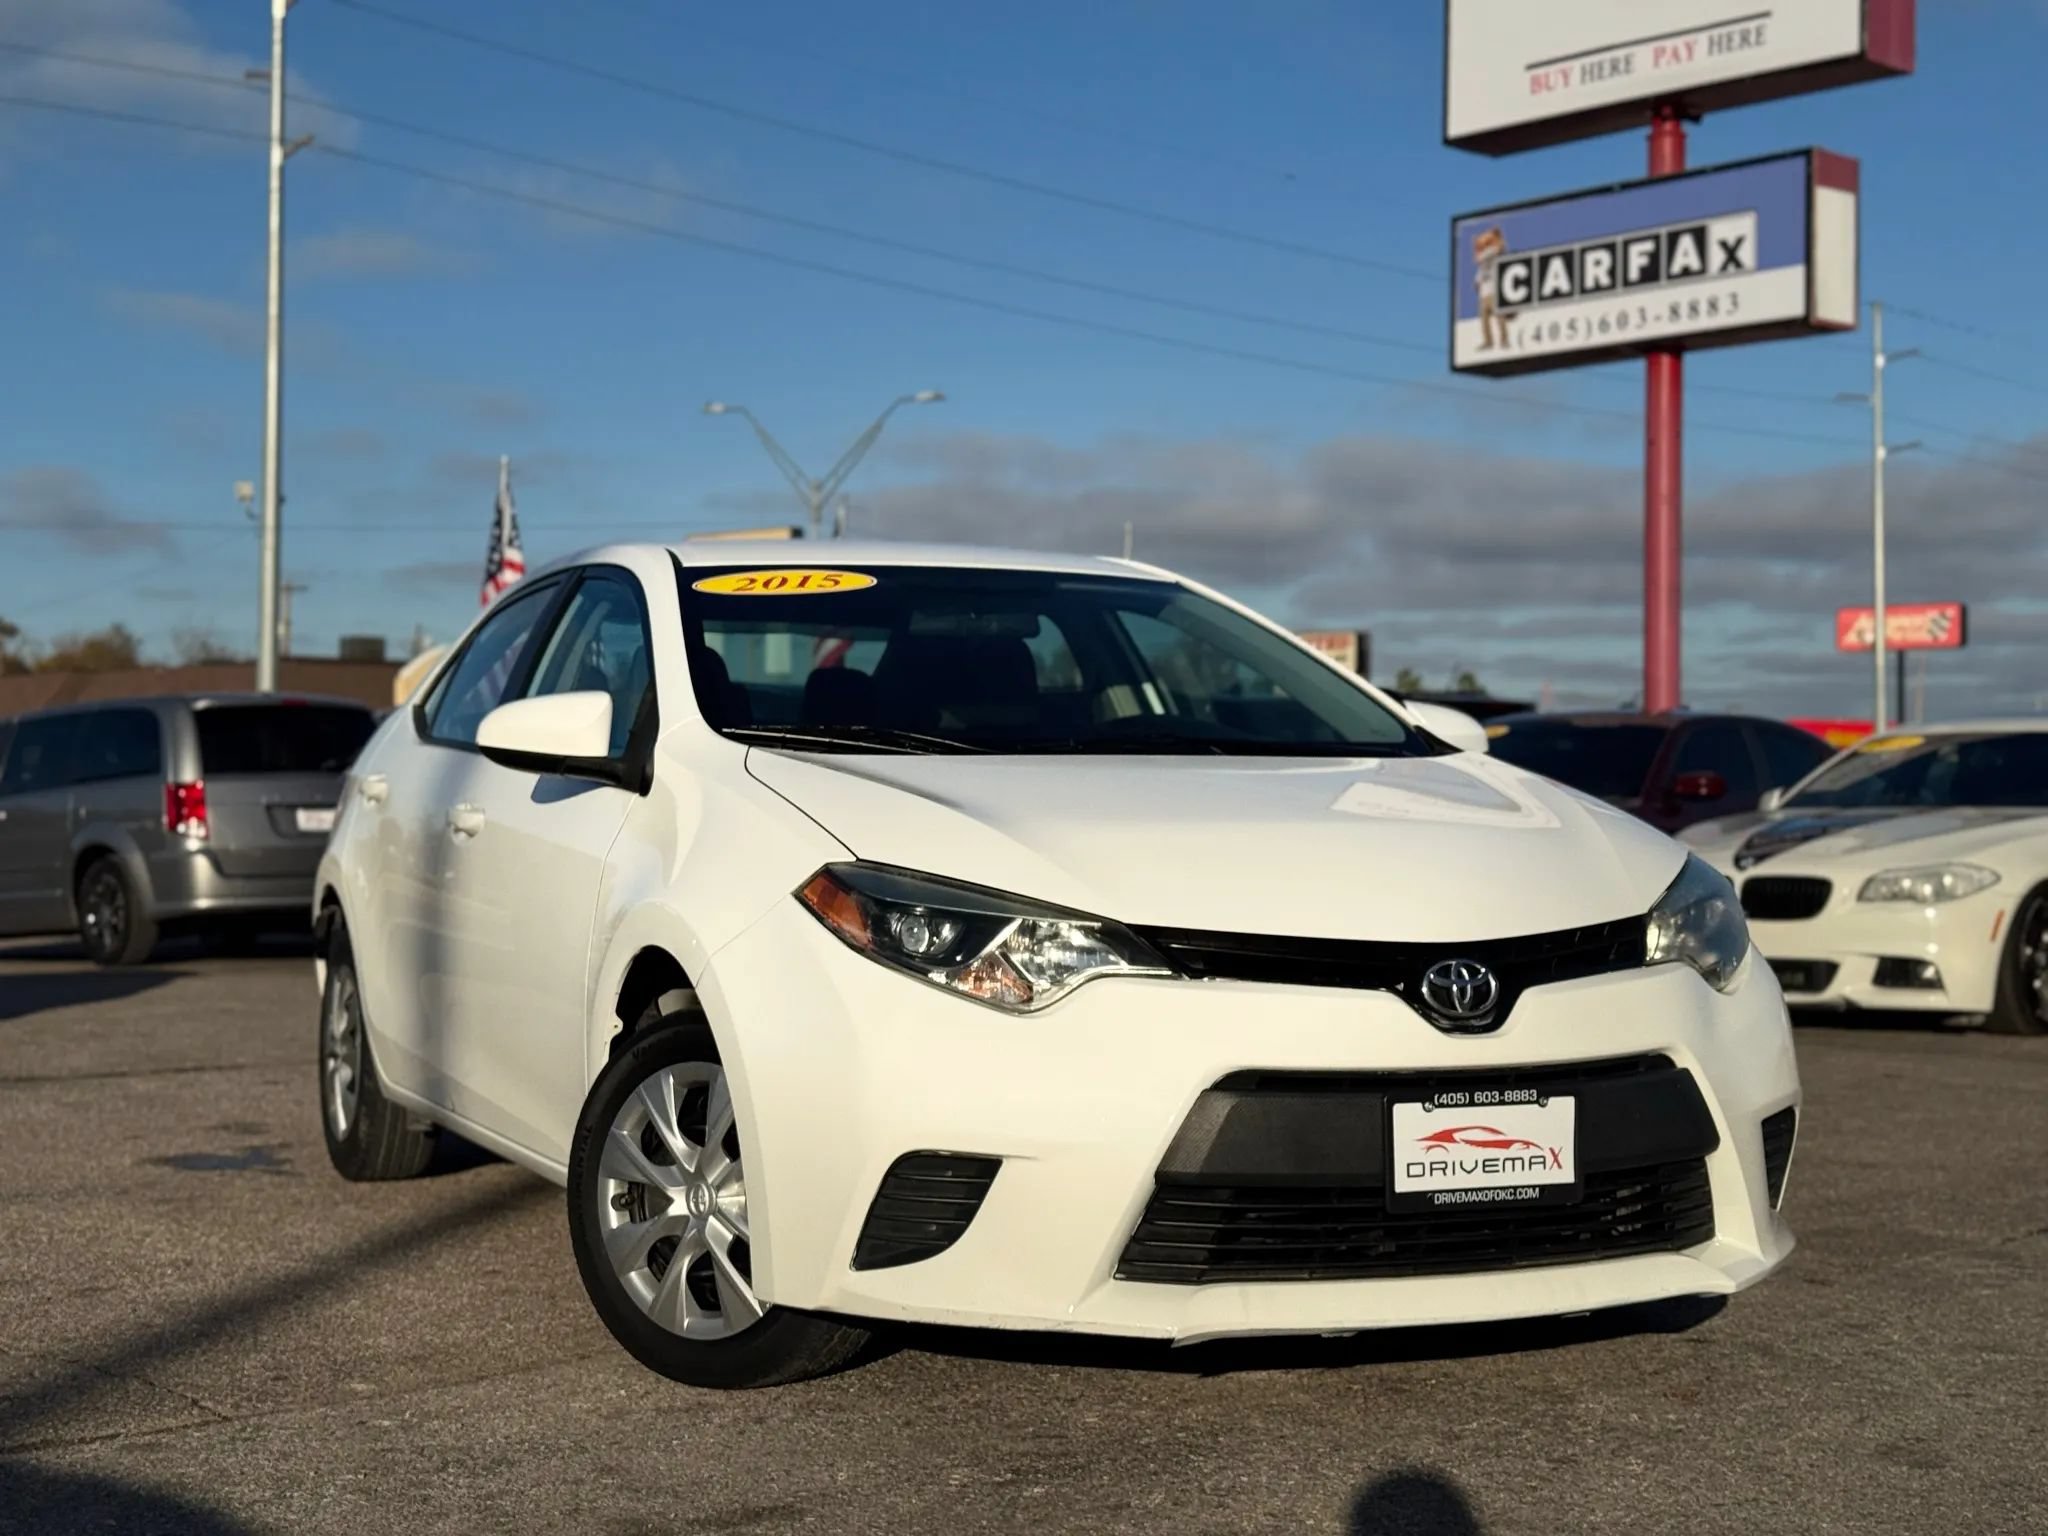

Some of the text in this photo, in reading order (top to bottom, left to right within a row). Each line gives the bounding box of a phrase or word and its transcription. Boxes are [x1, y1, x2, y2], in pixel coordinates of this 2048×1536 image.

[1529, 23, 1767, 95] BUY HERE PAY HERE
[1501, 231, 1746, 304] CARFAX
[1517, 291, 1741, 347] (405)603-8883
[732, 573, 844, 592] 2015
[1434, 1089, 1538, 1106] (405) 603-8883
[1406, 1146, 1563, 1179] DRIVEMAX
[1434, 1187, 1540, 1206] DRIVEMAXOFOKC.COM
